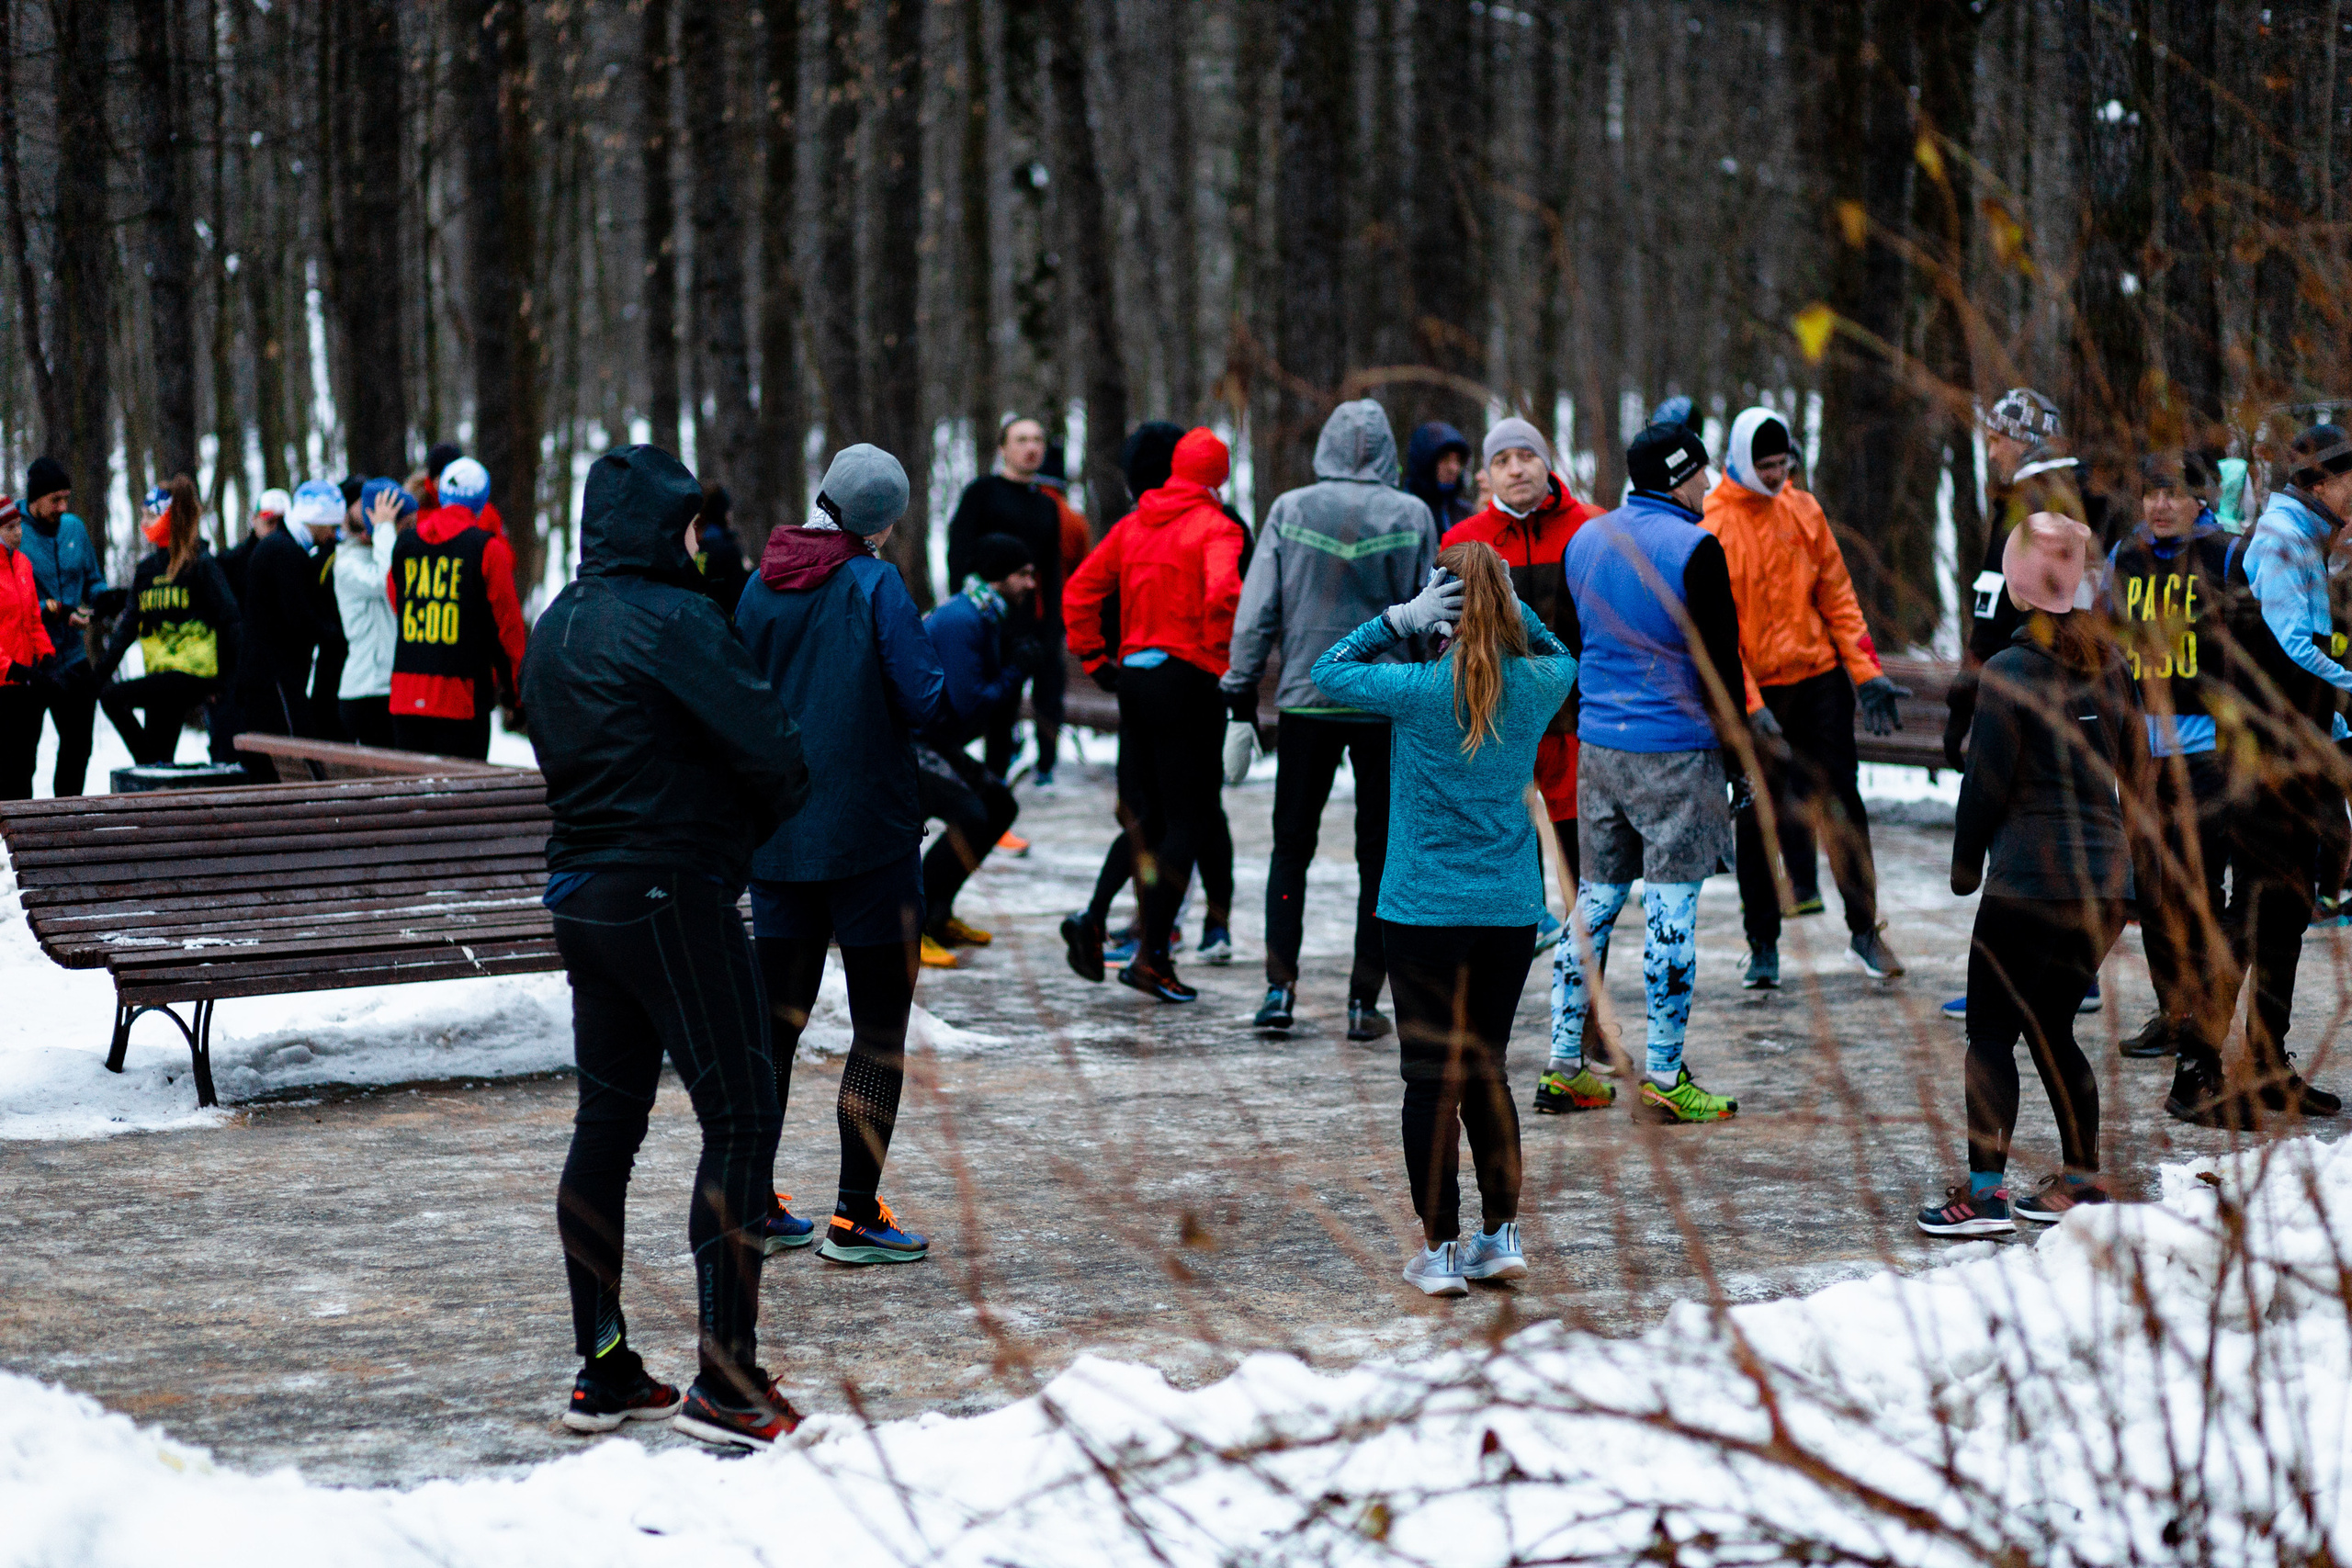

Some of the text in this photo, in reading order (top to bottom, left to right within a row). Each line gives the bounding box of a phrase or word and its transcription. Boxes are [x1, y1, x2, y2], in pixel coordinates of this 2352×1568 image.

[404, 555, 463, 600] PACE
[2127, 572, 2199, 624] PACE
[402, 600, 459, 645] 6:00
